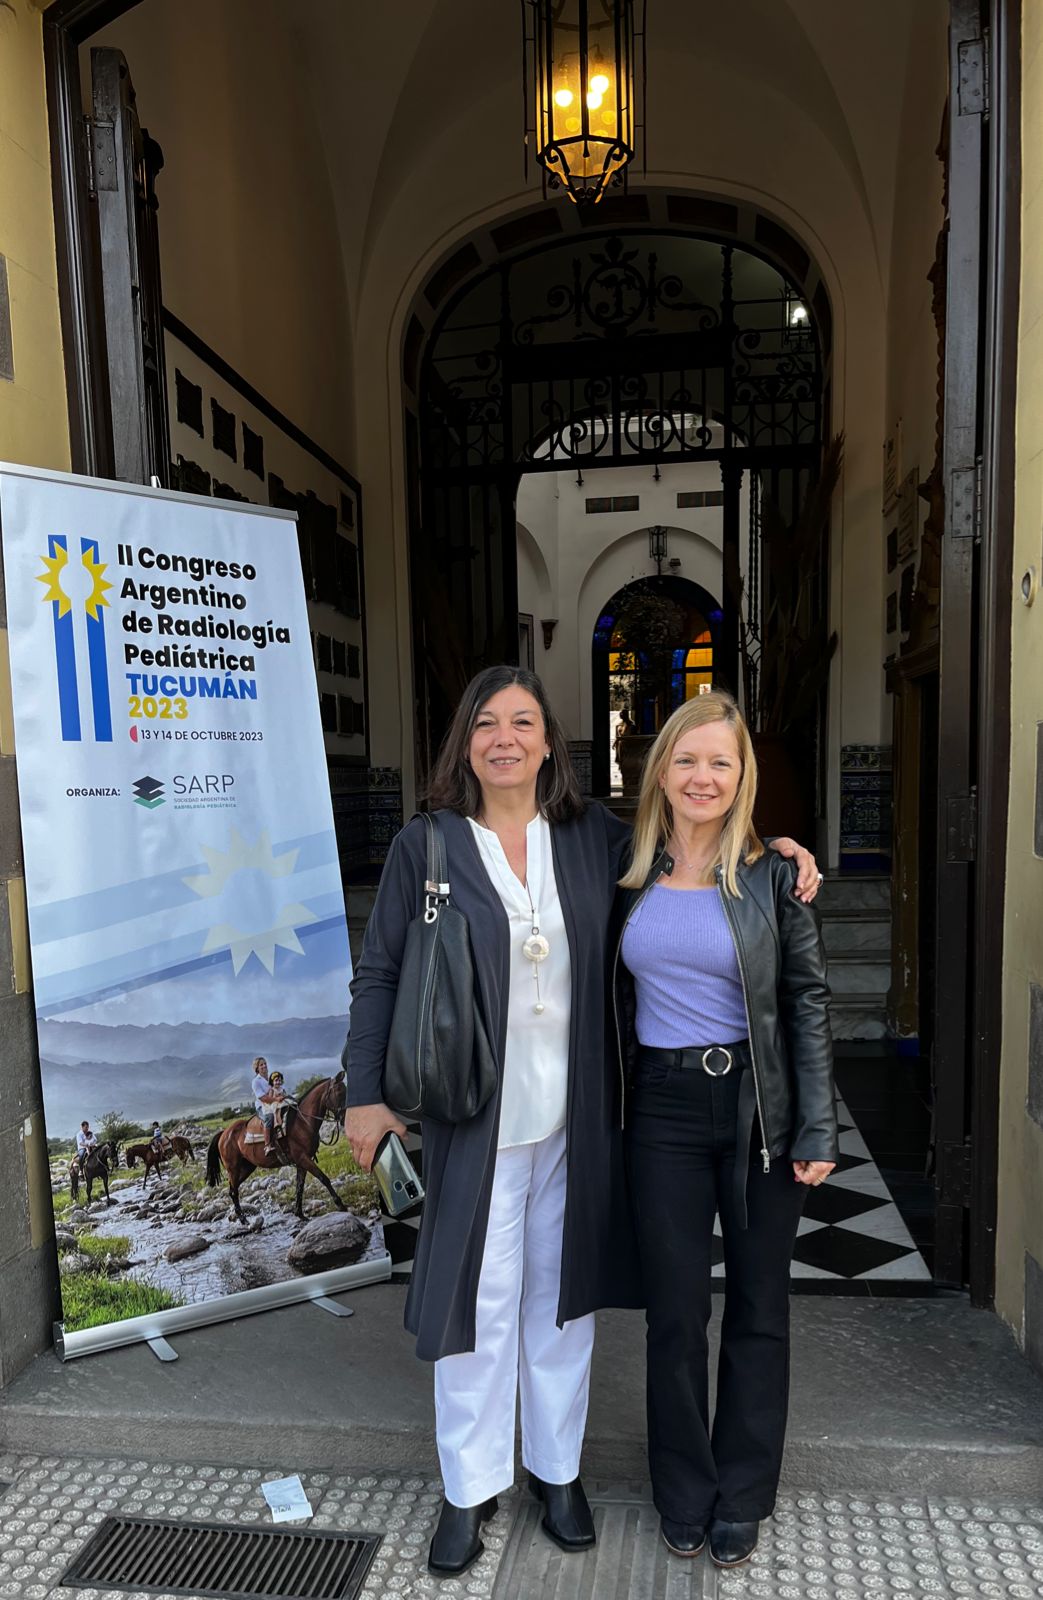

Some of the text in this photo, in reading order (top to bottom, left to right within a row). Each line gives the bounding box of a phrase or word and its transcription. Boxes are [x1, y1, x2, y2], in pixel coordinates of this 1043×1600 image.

[117, 543, 257, 582] II Congreso
[120, 577, 247, 610] Argentino
[122, 610, 291, 649] de Radiología
[124, 643, 256, 672] Pediátrica
[125, 671, 258, 700] TUCUMÁN
[128, 696, 189, 720] 2023
[140, 729, 263, 741] 13 Y 14 DE OCTUBRE 2023
[66, 787, 121, 797] ORGANIZA:
[173, 774, 235, 794] SARP
